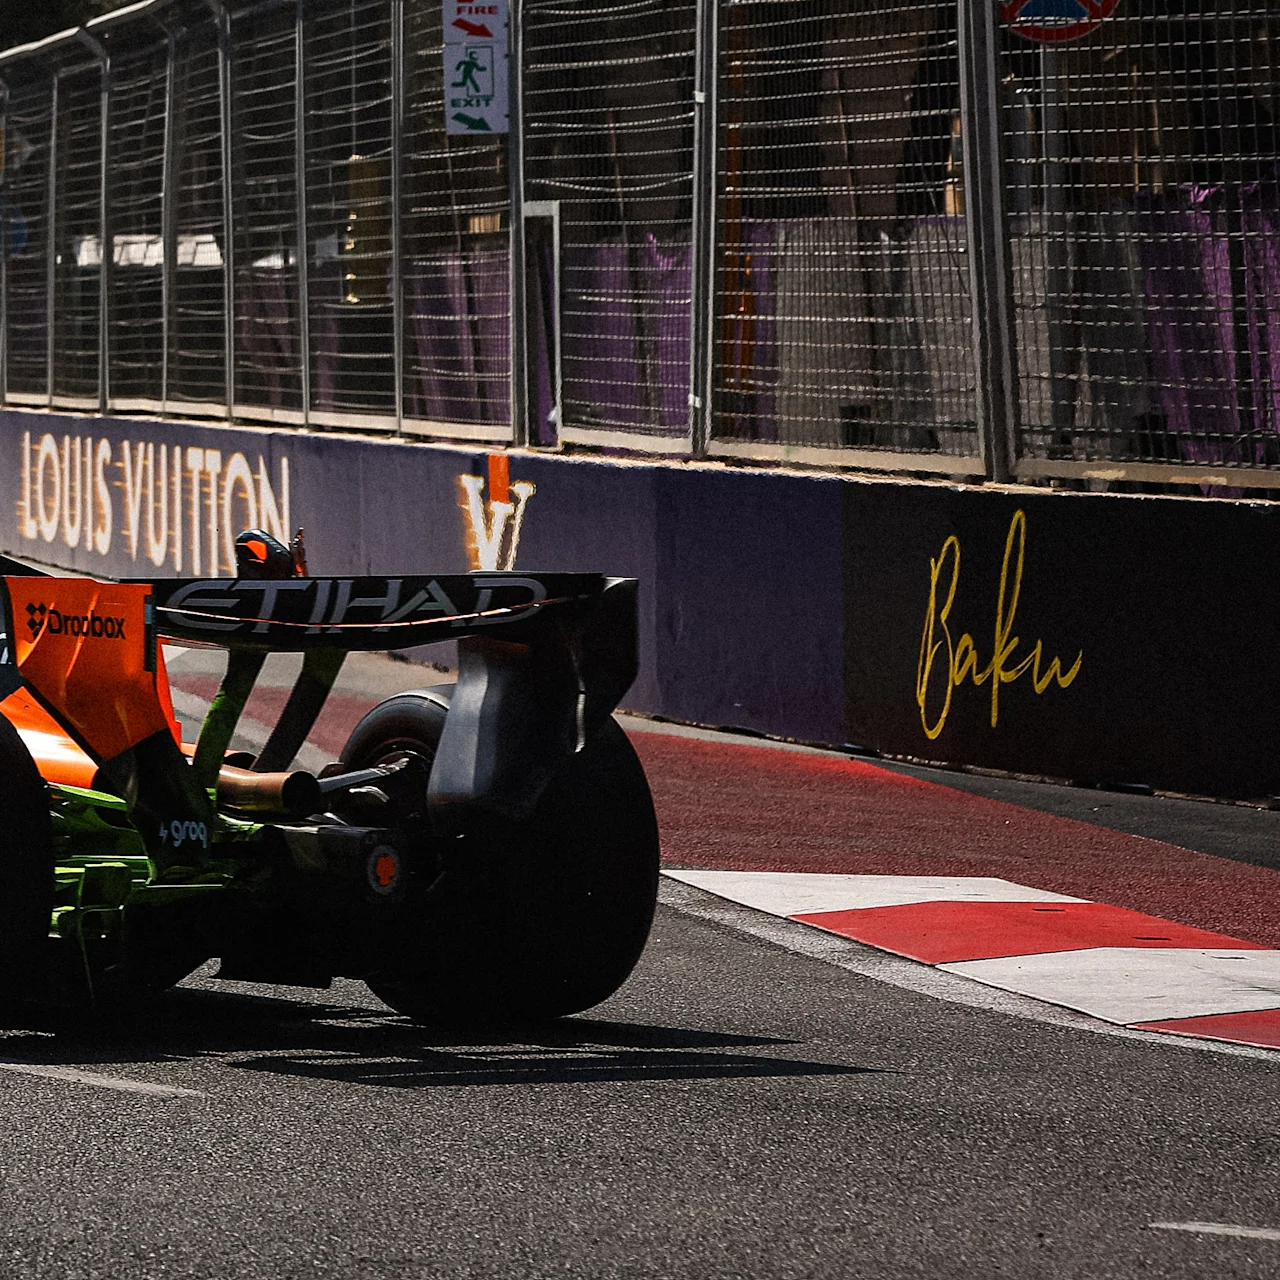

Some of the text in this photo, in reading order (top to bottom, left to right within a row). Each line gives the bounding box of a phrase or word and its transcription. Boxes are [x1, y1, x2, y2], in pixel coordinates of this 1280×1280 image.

[456, 5, 500, 15] FIRE
[450, 98, 492, 108] EXIT
[20, 430, 291, 579] LOUIS VUITTON
[164, 578, 548, 635] ETIHAD
[916, 508, 1083, 741] Baku
[169, 819, 208, 849] groq
